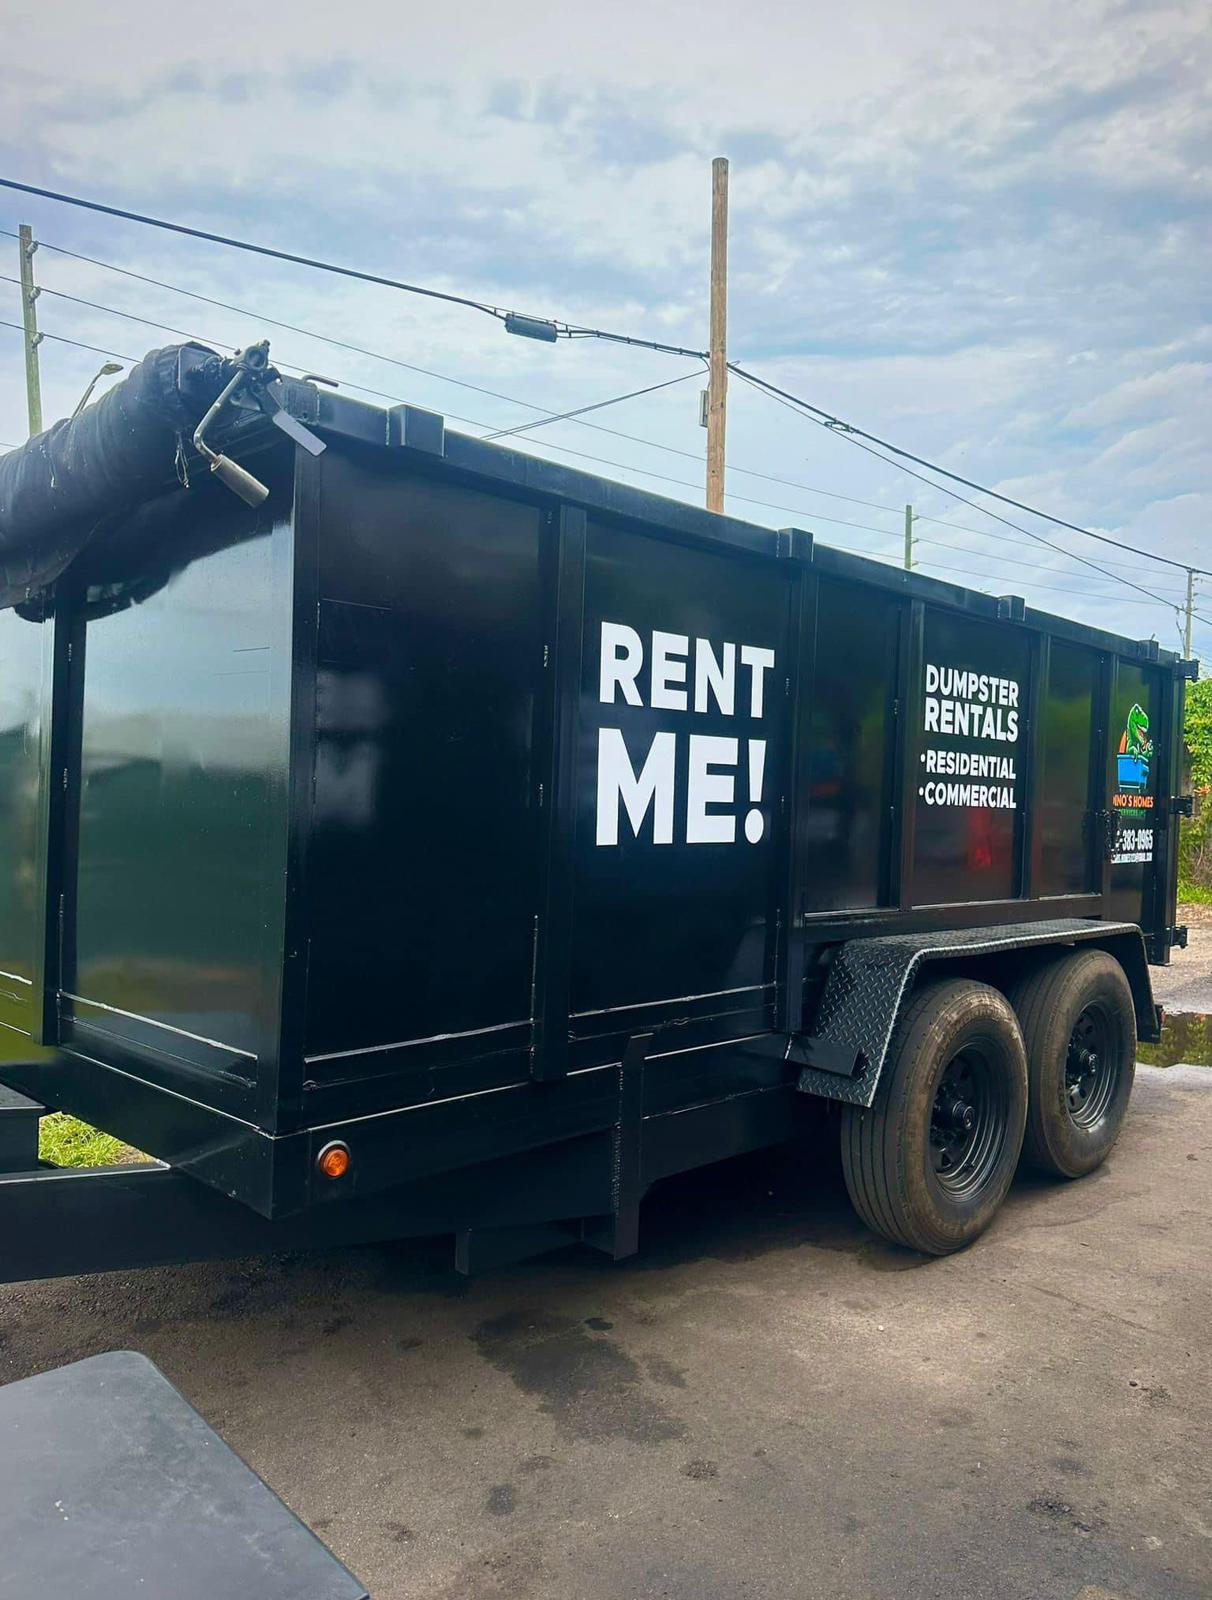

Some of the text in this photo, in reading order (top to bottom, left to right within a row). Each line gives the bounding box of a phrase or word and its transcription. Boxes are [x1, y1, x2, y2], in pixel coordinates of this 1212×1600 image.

[599, 621, 775, 719] RENT
[925, 664, 1019, 708] DUMPSTER
[924, 696, 1019, 743] RENTALS
[595, 727, 767, 846] ME!
[1133, 795, 1154, 808] HOMES
